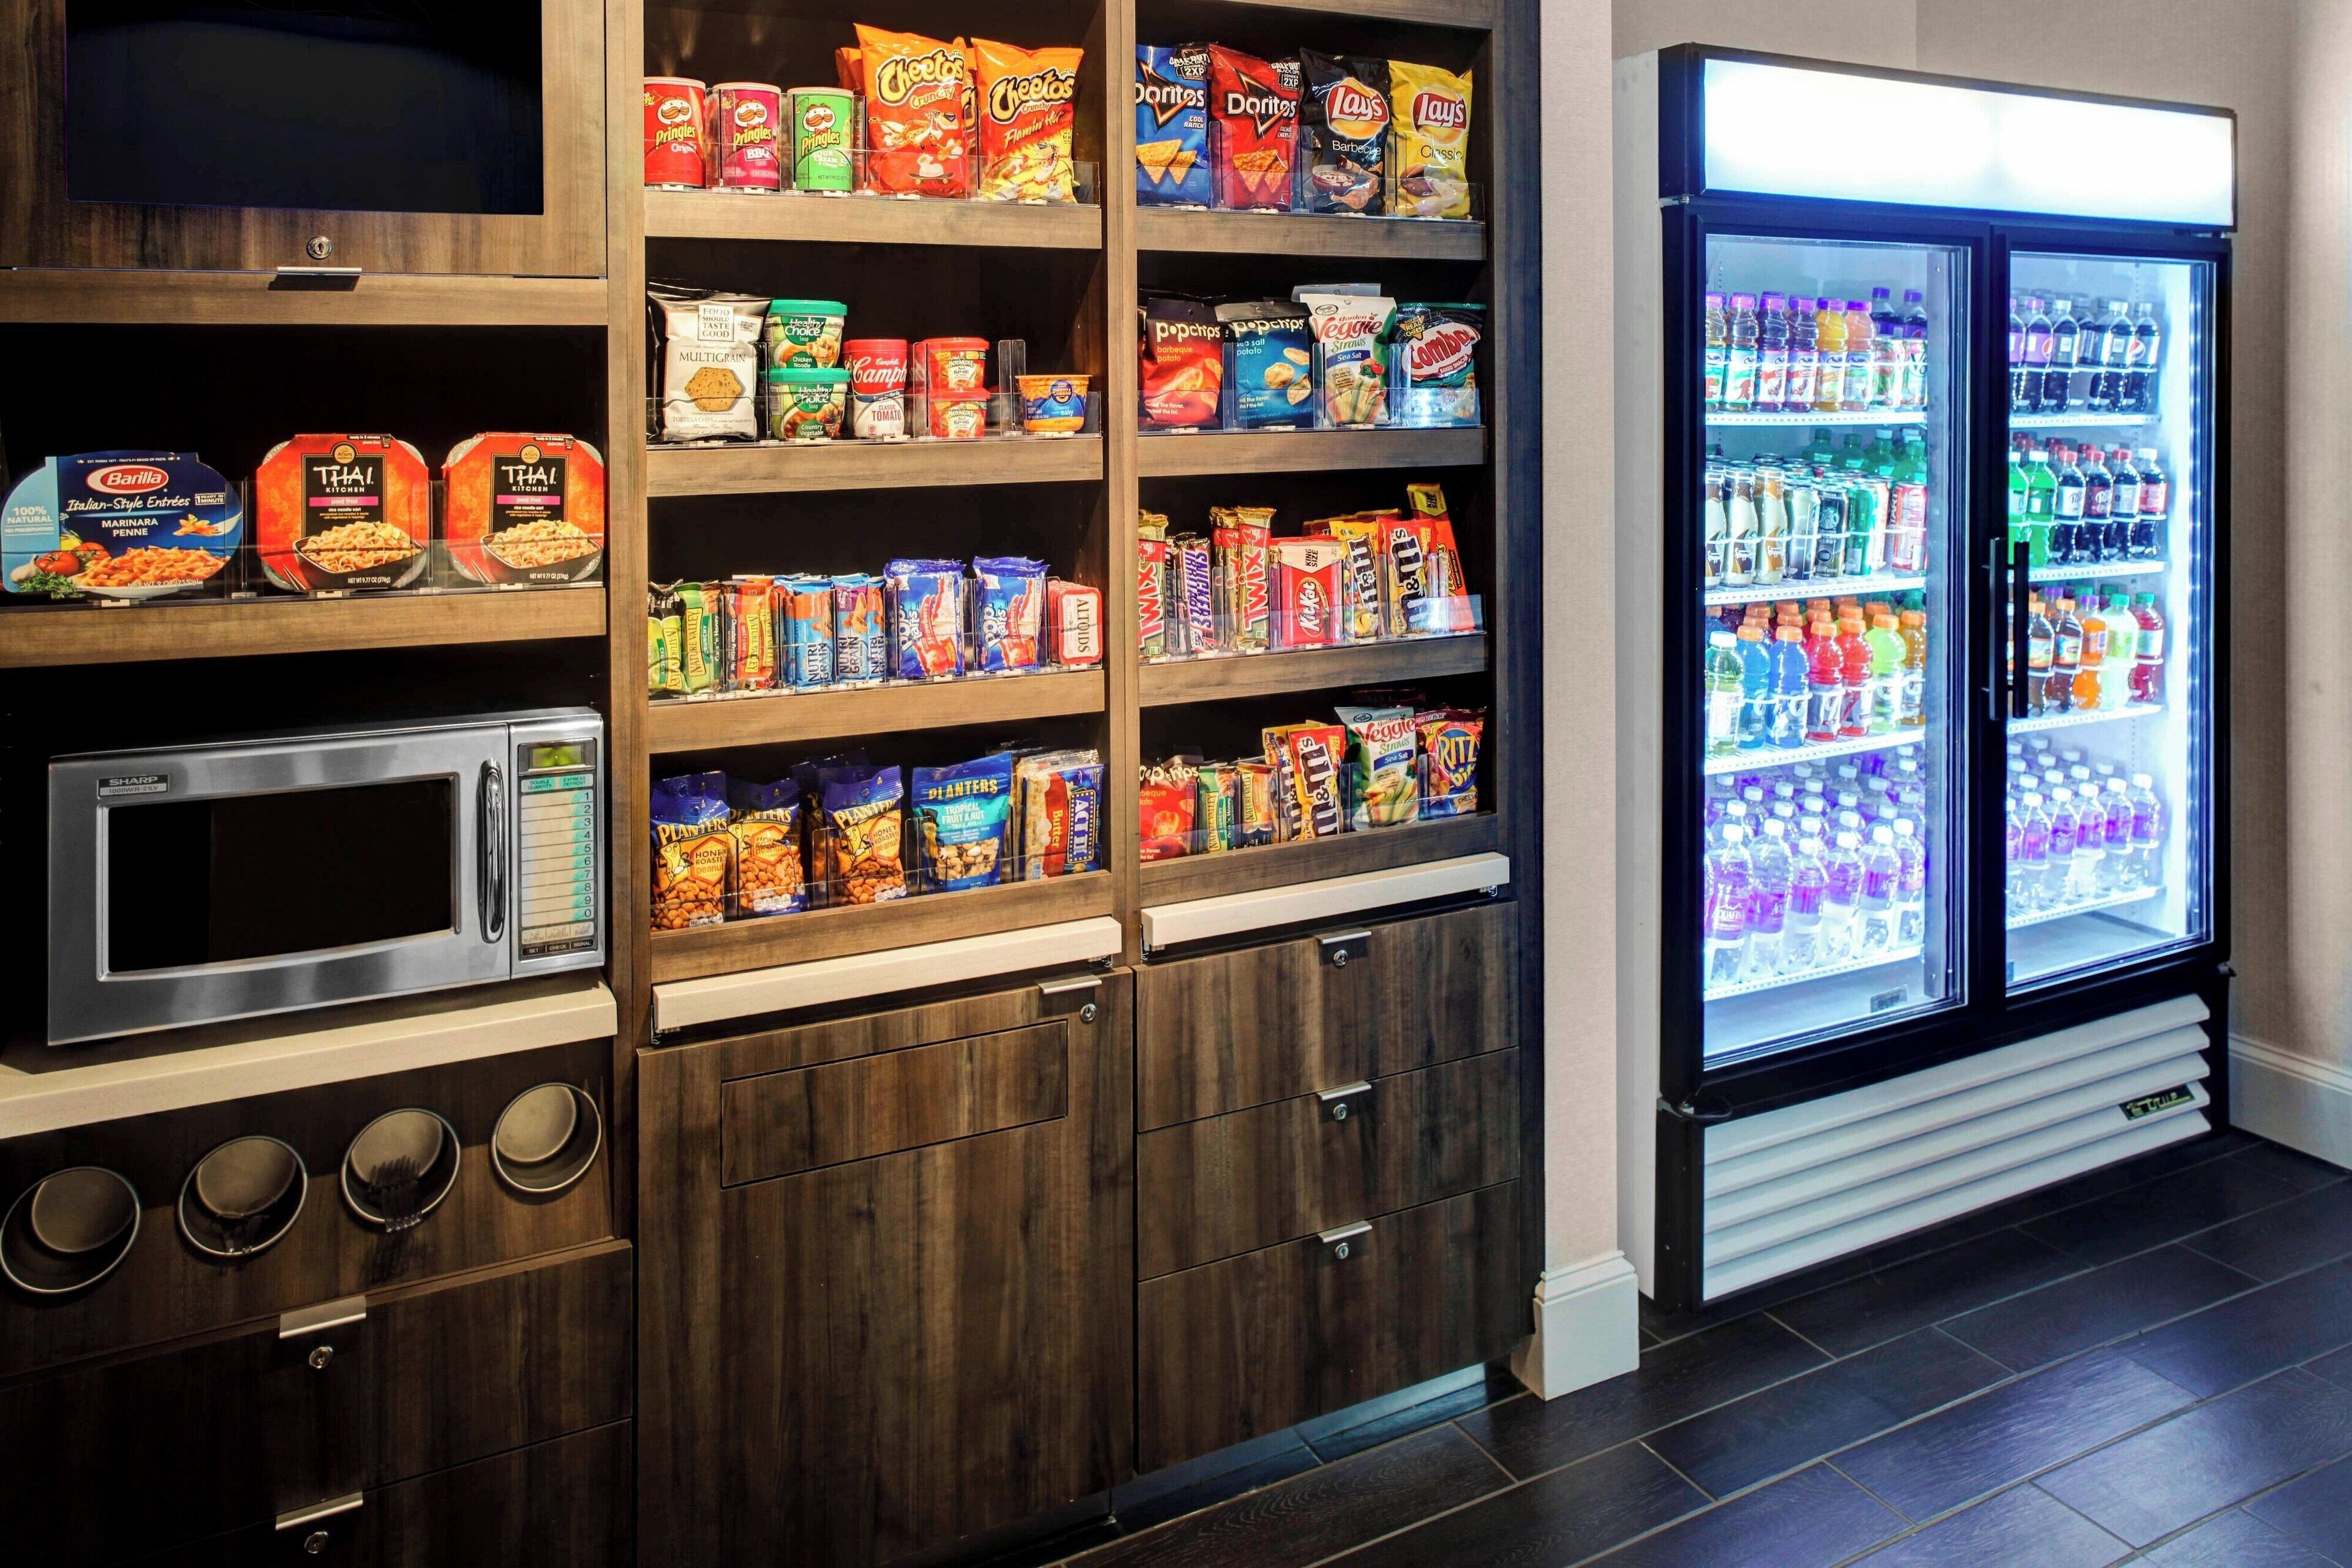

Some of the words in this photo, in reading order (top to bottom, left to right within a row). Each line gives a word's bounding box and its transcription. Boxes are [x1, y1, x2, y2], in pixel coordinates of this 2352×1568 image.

[878, 50, 965, 104] Cheetos
[1184, 67, 1204, 76] 2XP
[1283, 78, 1298, 87] 2XP
[910, 87, 956, 110] Crunchy
[990, 68, 1075, 121] Cheetos
[1136, 82, 1205, 107] Doritos
[1332, 87, 1384, 121] Lay's
[1022, 102, 1050, 115] Crunchy
[1227, 92, 1297, 118] Doritos
[1417, 94, 1464, 127] Lay's
[1044, 111, 1065, 127] Hot
[655, 122, 696, 150] Pringles
[733, 124, 772, 152] Pringles
[801, 127, 840, 157] Pringles
[745, 146, 771, 159] BBQ
[1332, 140, 1382, 154] Barbecue
[1420, 145, 1463, 160] Classic
[785, 326, 821, 337] Choice
[790, 317, 824, 328] Healthy
[1156, 322, 1221, 342] popchips
[1232, 318, 1305, 337] popchips
[1312, 315, 1382, 342] Veggie
[1404, 326, 1426, 337] CHEESE
[1405, 322, 1422, 331] REAL
[1236, 348, 1262, 356] potato
[1332, 337, 1366, 353] Straws
[679, 352, 746, 363] MULTIGRAIN
[793, 393, 829, 404] Choice
[798, 385, 832, 394] Healthy
[872, 410, 902, 421] TOMATO
[107, 471, 162, 486] Barilla
[313, 466, 372, 487] THAI
[501, 465, 556, 486] THAI
[13, 506, 47, 516] 100%
[66, 496, 143, 513] Italian-Style
[147, 496, 190, 509] Entrées
[7, 516, 53, 524] NATURAL
[102, 518, 159, 527] MARINARA
[113, 528, 148, 537] PENNE
[1194, 552, 1212, 629] SNICKERS
[1244, 548, 1269, 631] TWIX
[688, 611, 699, 640] VALLEY
[747, 616, 759, 645] NATURE
[922, 603, 935, 645] Strawberry
[1009, 603, 1019, 643] Strawberry
[1077, 598, 1090, 653] ALTOIDS
[688, 640, 703, 673] NATURE
[807, 644, 820, 682] NUTRI
[818, 643, 829, 679] GRAIN
[838, 637, 850, 673] NUTRI
[848, 636, 861, 674] GRAIN
[870, 636, 880, 674] NUTRI
[1354, 717, 1416, 745] Veggie
[1379, 736, 1410, 756] Straws
[1438, 736, 1477, 769] RITZ
[1398, 752, 1408, 761] Salt
[109, 776, 158, 786] SHARP
[929, 778, 998, 800] PLANTERS
[584, 805, 590, 813] 2
[944, 802, 979, 815] TROPICAL
[1074, 799, 1089, 833] ACT
[1207, 794, 1216, 820] VALLEY
[1243, 796, 1254, 821] NATURE
[584, 818, 591, 827] 3
[942, 813, 963, 824] FRUIT
[970, 810, 985, 821] NUT
[584, 831, 591, 840] 4
[657, 818, 728, 846] PLANTERS
[873, 824, 897, 837] HONEY
[1052, 809, 1064, 848] Butter
[1208, 820, 1219, 849] NATURE
[584, 843, 591, 853] 5
[875, 832, 900, 845] ROASTED
[1073, 834, 1088, 855] II
[584, 857, 591, 866] 6
[584, 870, 591, 879] 7
[584, 883, 591, 892] 8
[584, 896, 591, 905] 9
[584, 909, 591, 918] 0
